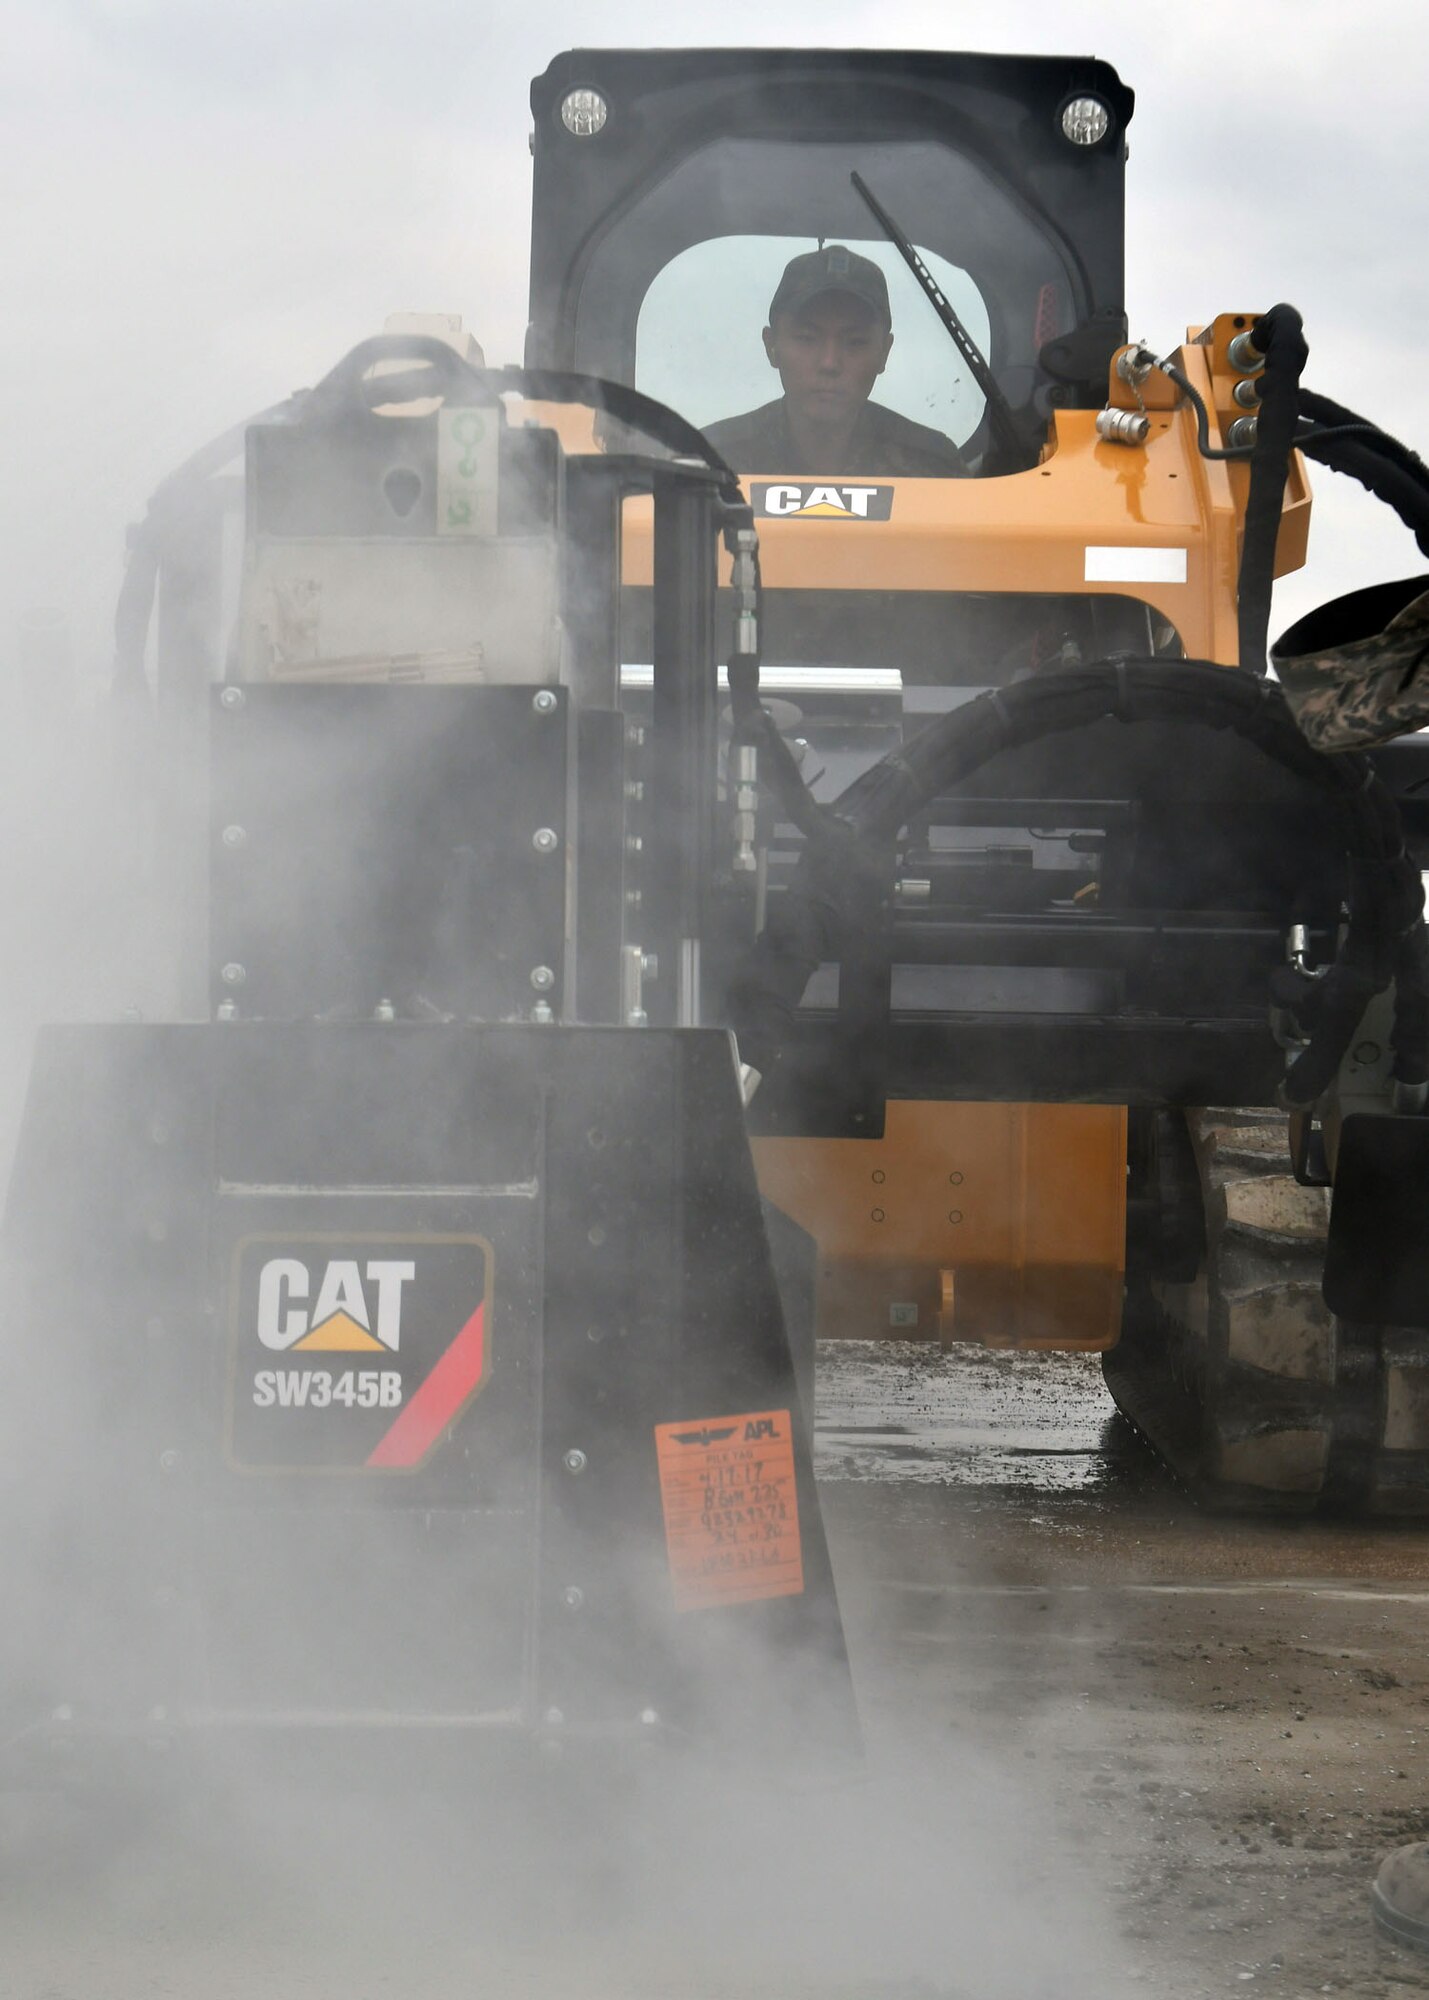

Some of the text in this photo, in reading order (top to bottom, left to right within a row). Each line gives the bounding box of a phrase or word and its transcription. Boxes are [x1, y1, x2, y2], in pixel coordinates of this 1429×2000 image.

[765, 486, 877, 517] CAT
[257, 1258, 416, 1352] CAT
[252, 1370, 402, 1408] SW345B
[744, 1418, 780, 1442] APL
